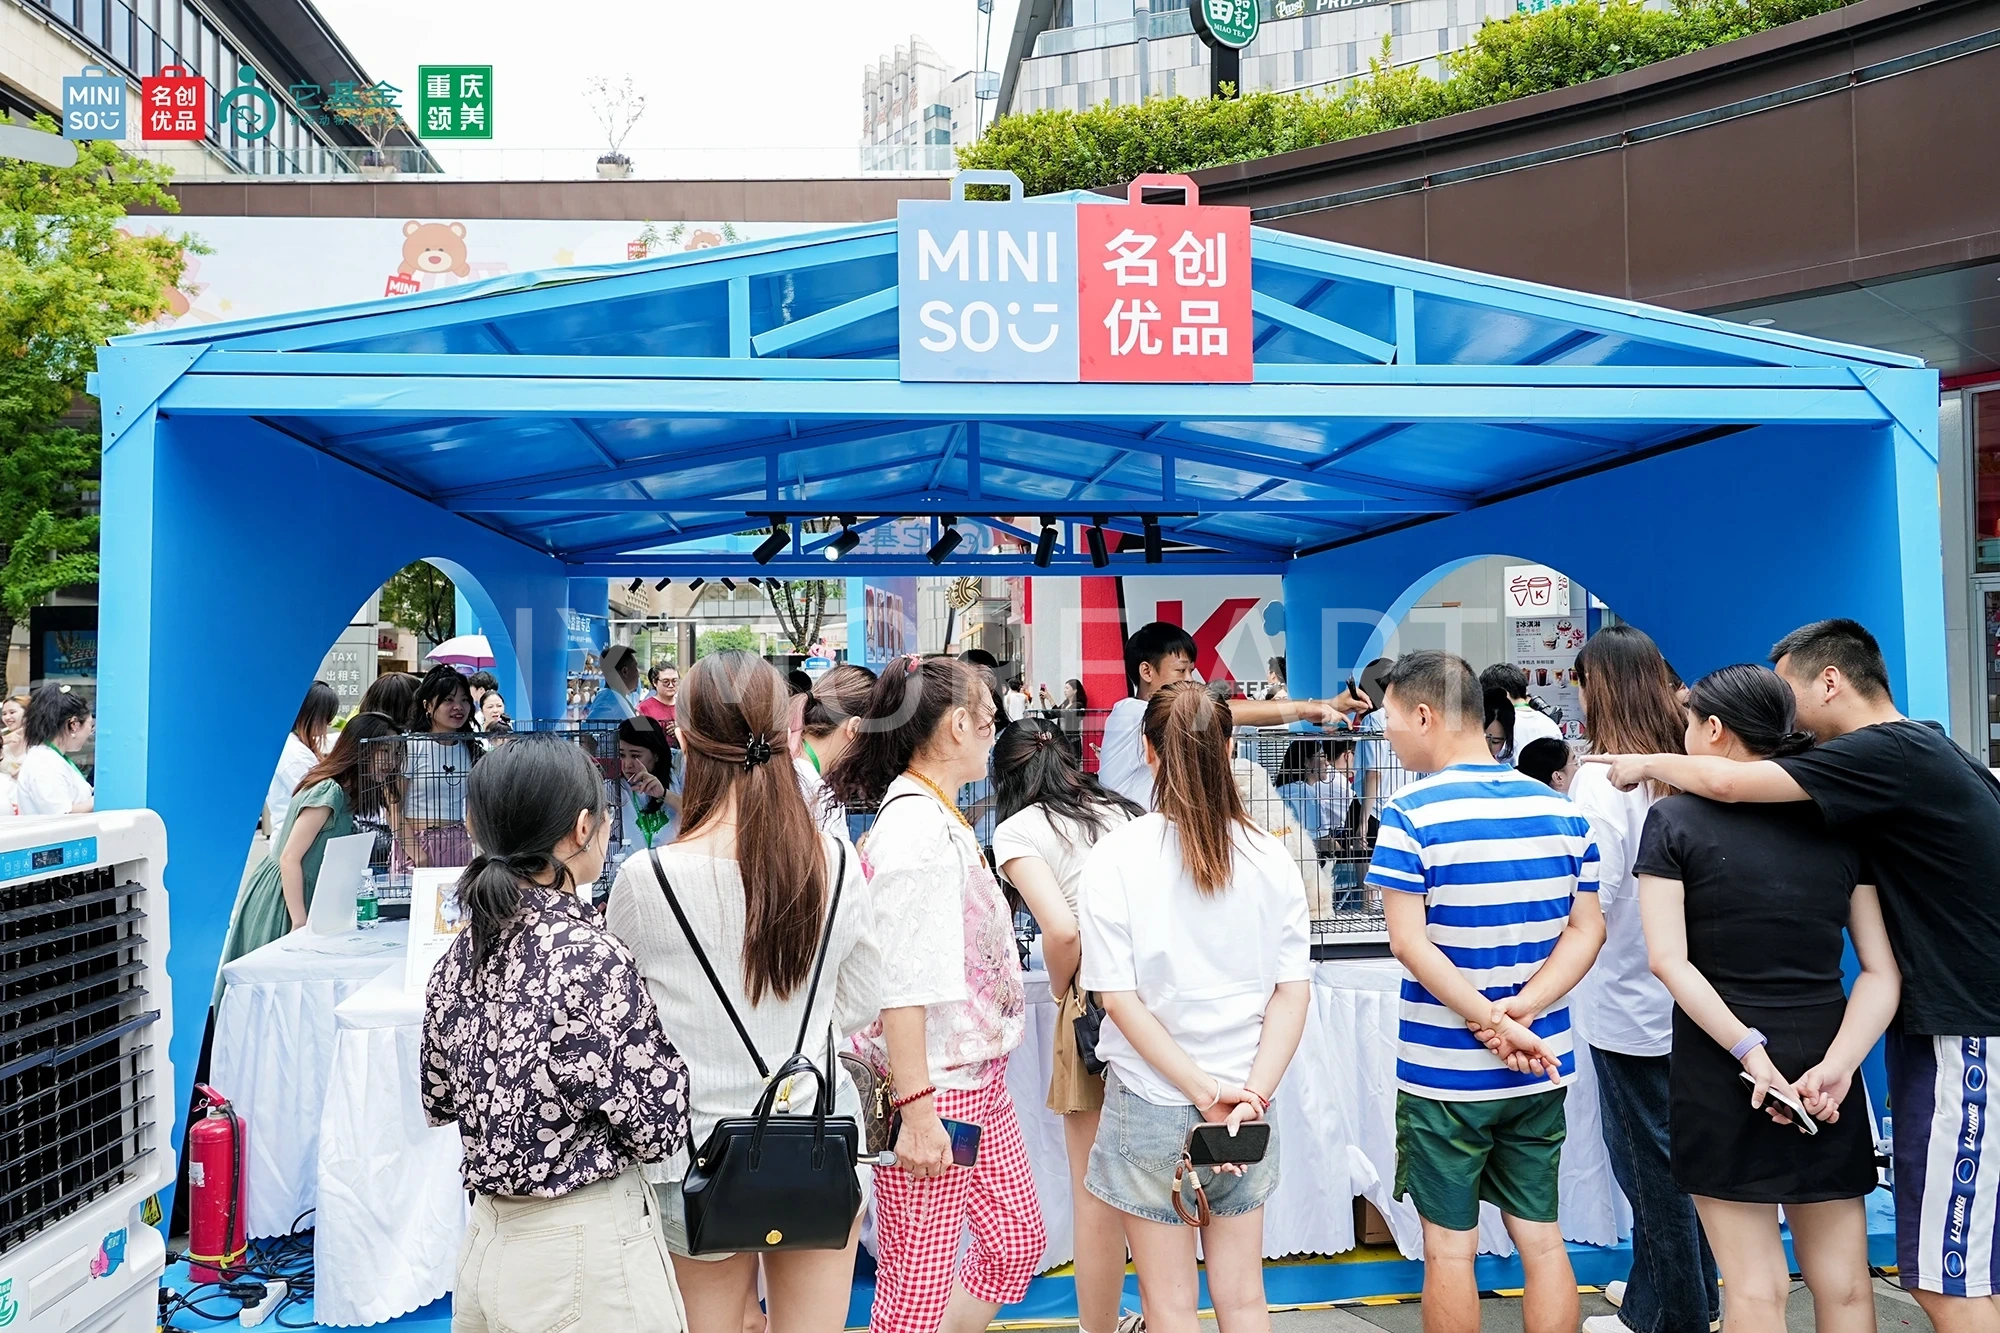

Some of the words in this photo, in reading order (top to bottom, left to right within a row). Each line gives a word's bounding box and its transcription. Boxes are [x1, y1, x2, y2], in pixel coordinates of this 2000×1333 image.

[1213, 23, 1232, 34] MIAO
[1232, 29, 1246, 38] TEA
[918, 229, 1058, 283] MINI
[1102, 228, 1228, 288] 名创
[389, 280, 418, 294] MINI
[1102, 298, 1229, 356] 优品
[326, 670, 360, 681] 出租车
[331, 652, 357, 661] TAXI
[1963, 1102, 1979, 1151] LI-NING
[1950, 1194, 1967, 1244] LI-NING
